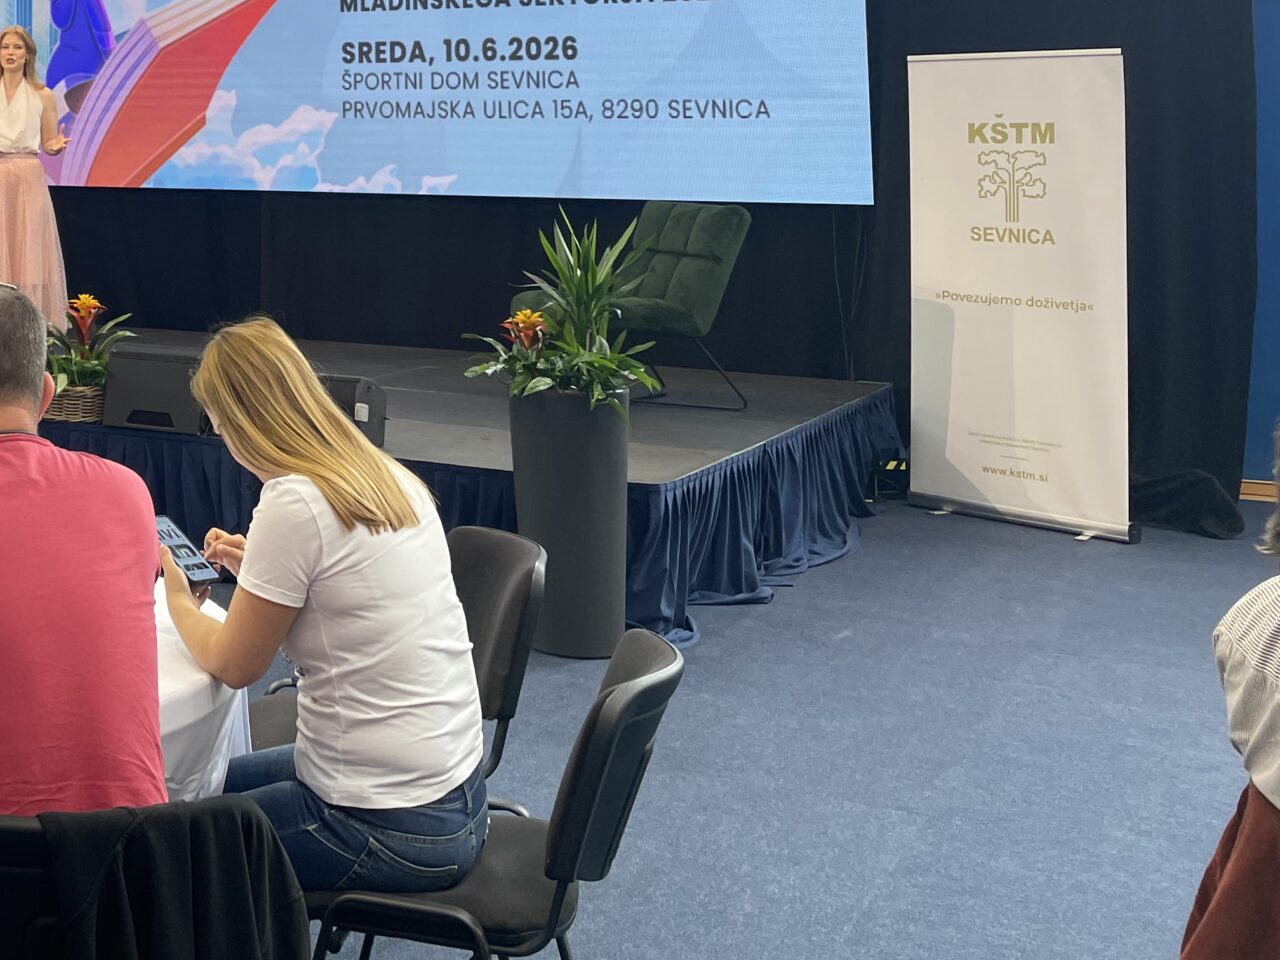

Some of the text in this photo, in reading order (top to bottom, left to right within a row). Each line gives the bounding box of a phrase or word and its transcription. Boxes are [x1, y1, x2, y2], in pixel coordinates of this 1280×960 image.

[341, 35, 579, 66] SREDA, 10.6.2026
[341, 69, 580, 91] ŠPORTNI DOM SEVNICA
[342, 98, 771, 123] PRVOMAJSKA ULICA 15A, 8290 SEVNICA
[967, 113, 1056, 145] KŠTM
[969, 226, 1056, 245] SEVNICA
[981, 465, 1049, 483] www.kstm.si
